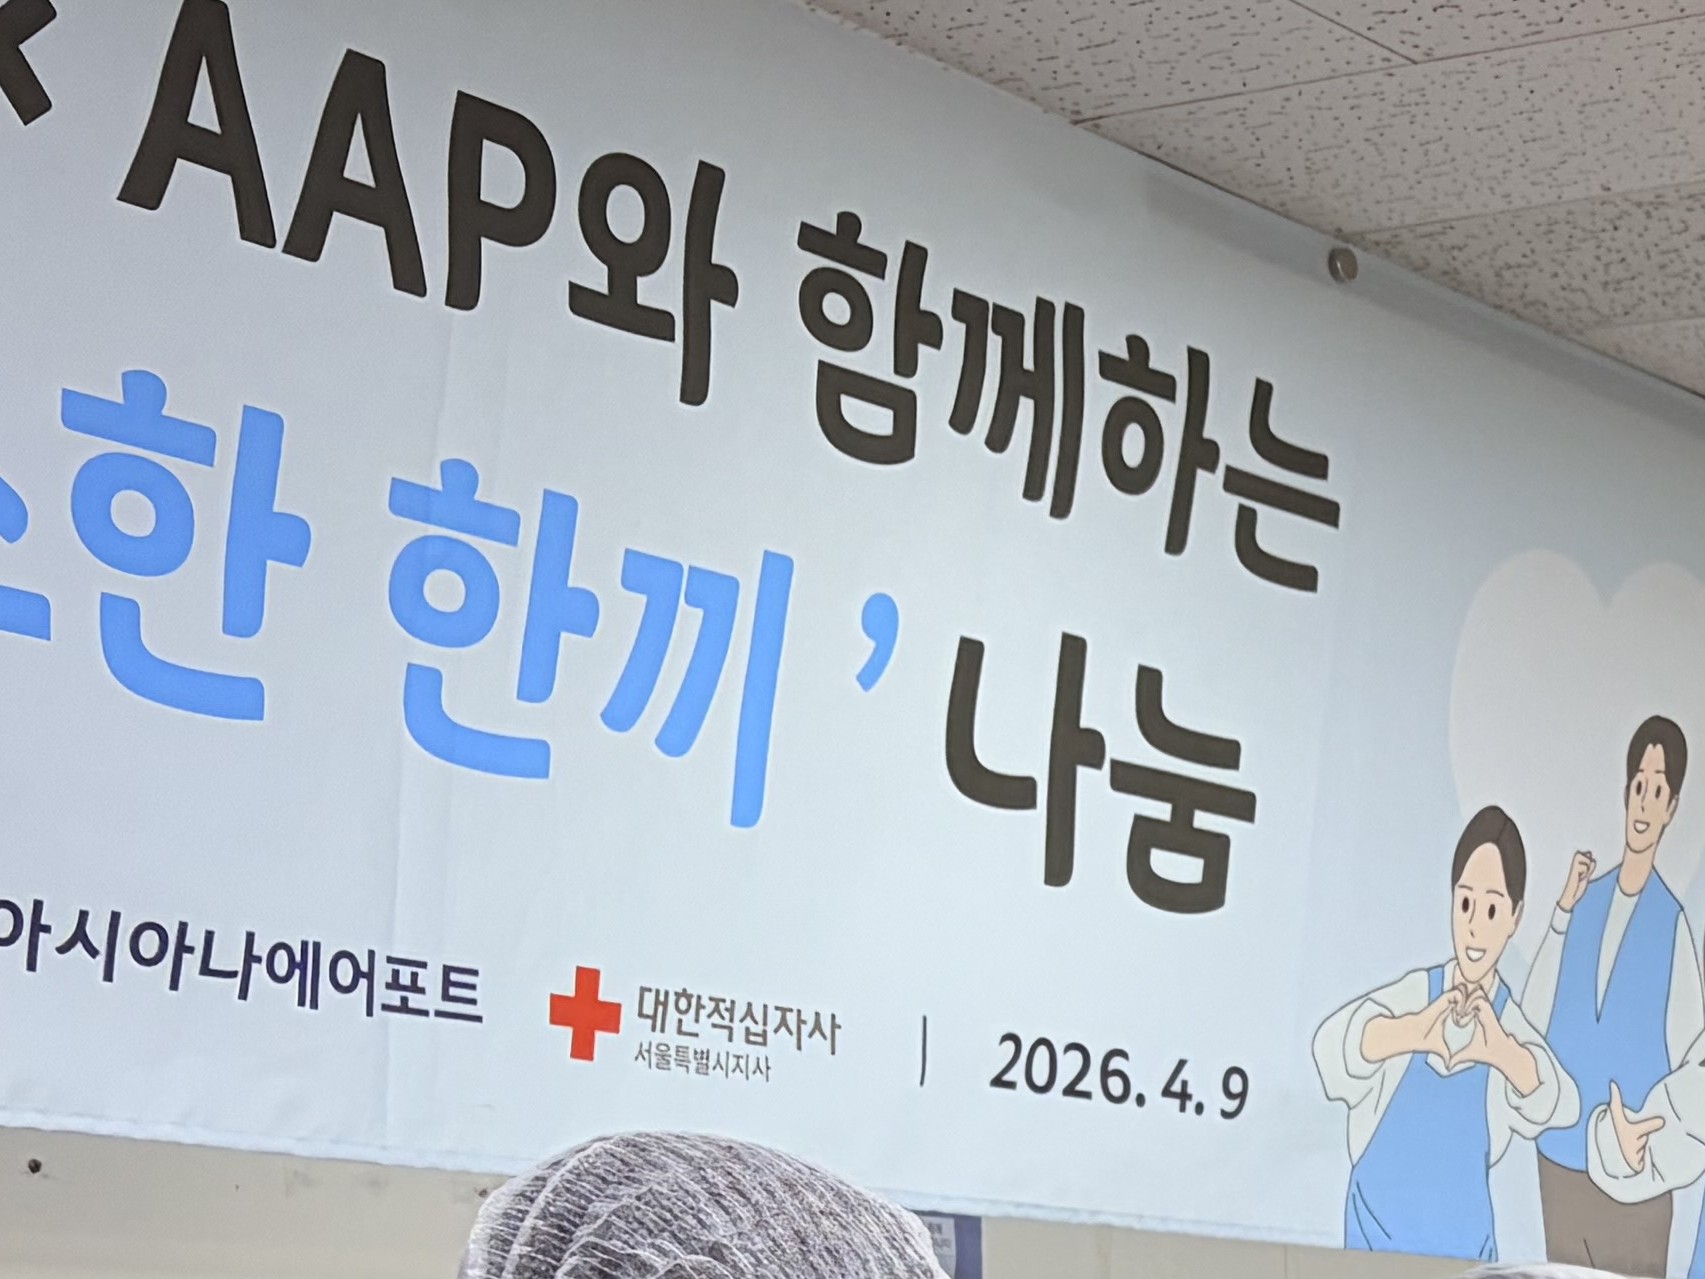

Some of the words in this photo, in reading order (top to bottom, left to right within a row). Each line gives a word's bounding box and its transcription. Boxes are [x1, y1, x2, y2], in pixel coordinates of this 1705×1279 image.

[117, 0, 738, 406] AAP와
[797, 211, 1341, 593] 함께하는
[388, 457, 795, 828] 한끼
[945, 631, 1257, 914] 나눔
[0, 898, 484, 1023] 아시아나에어포트
[636, 985, 842, 1056] 대한적십자사
[633, 1042, 772, 1083] 서울특별시지사
